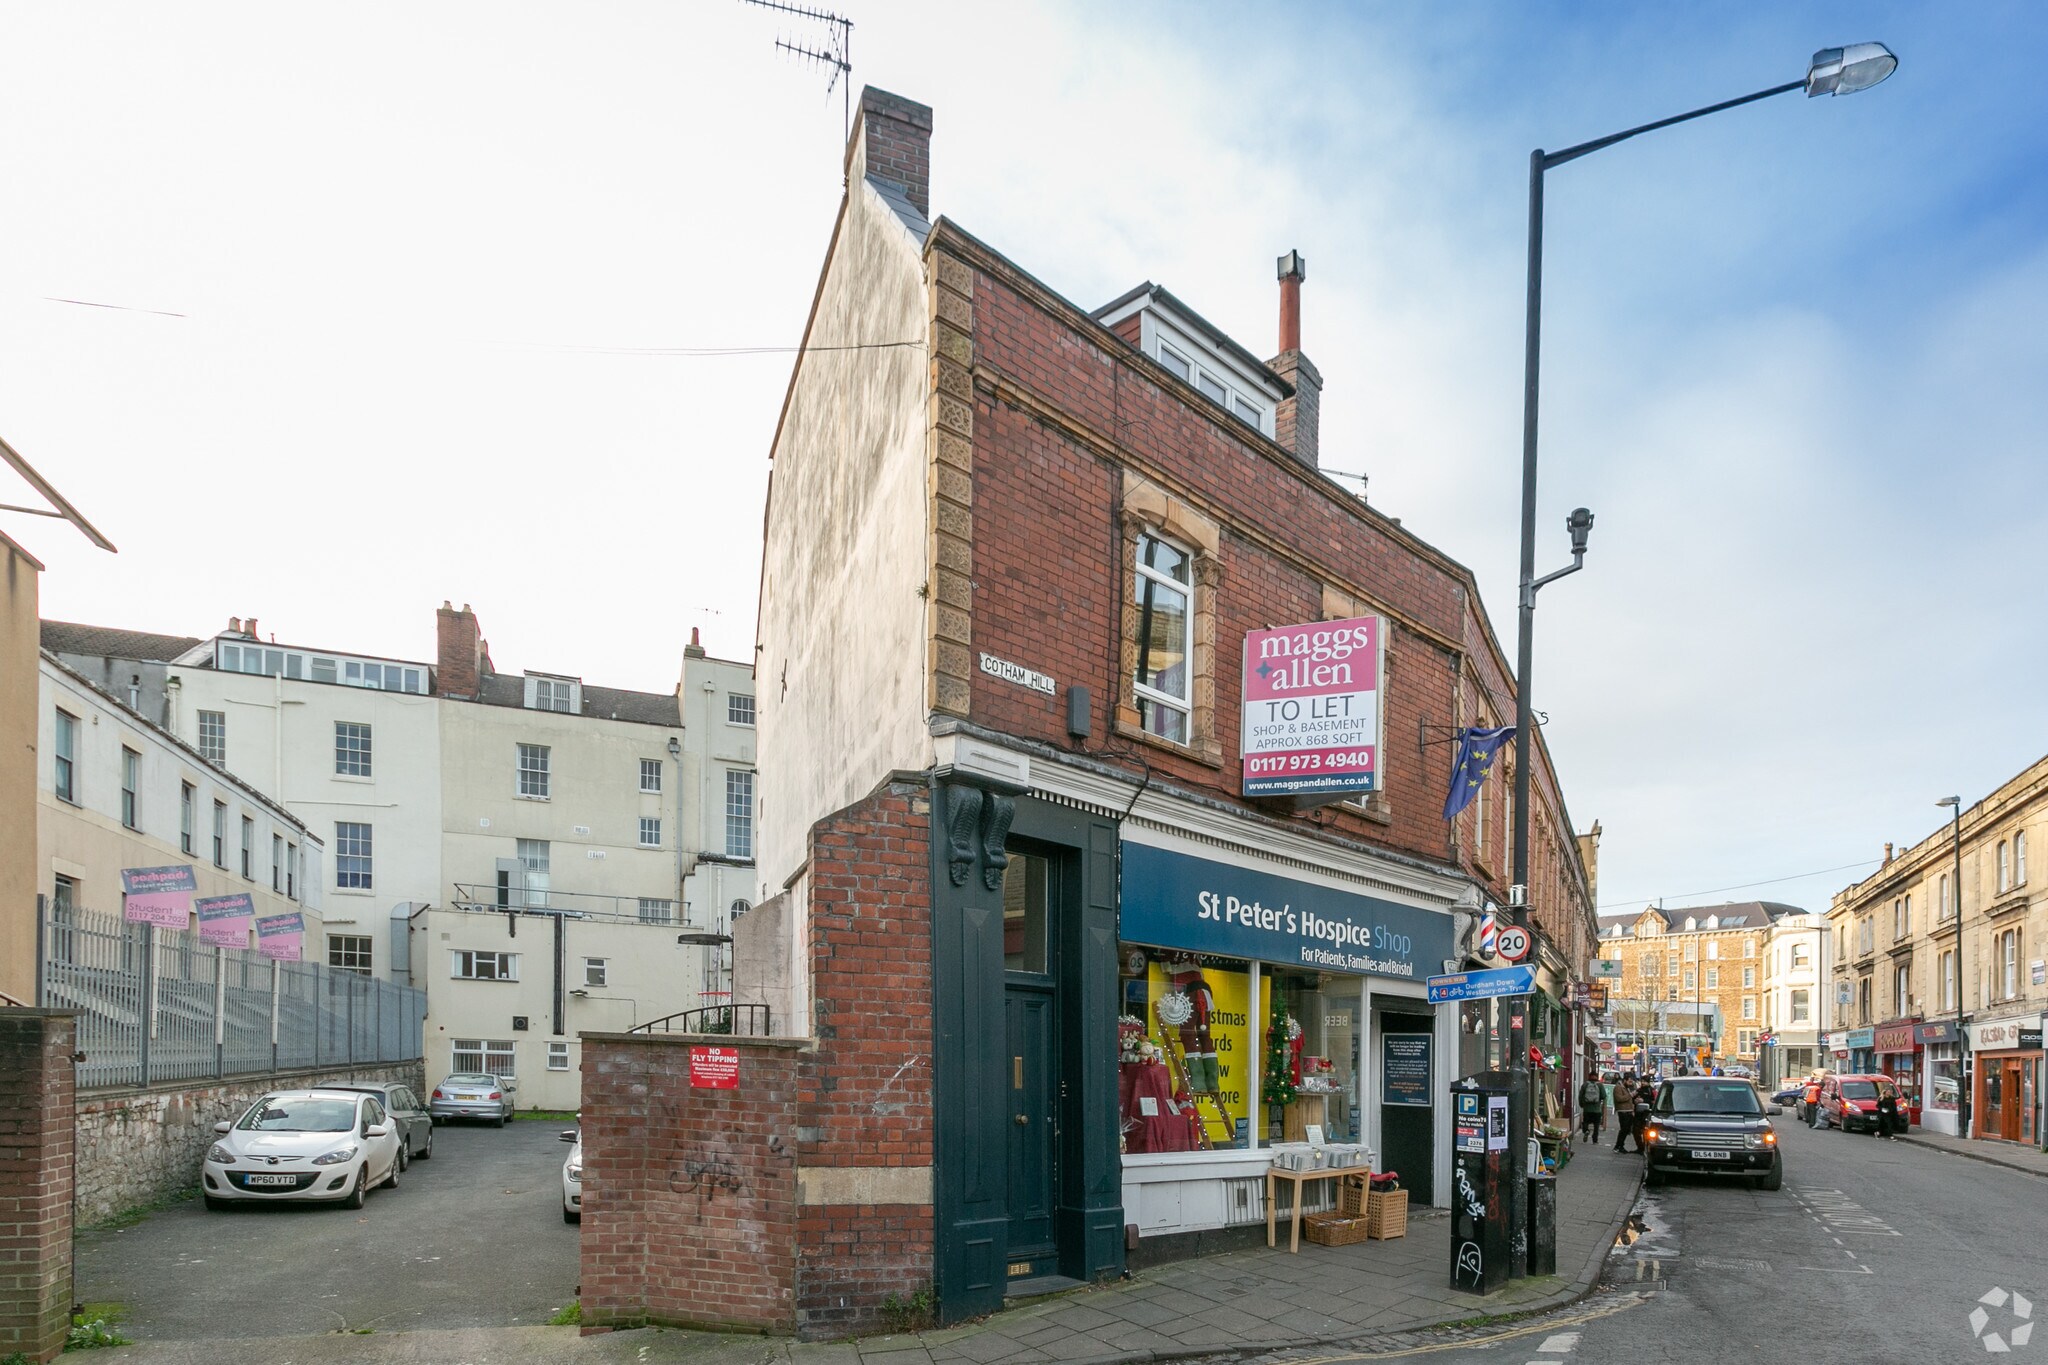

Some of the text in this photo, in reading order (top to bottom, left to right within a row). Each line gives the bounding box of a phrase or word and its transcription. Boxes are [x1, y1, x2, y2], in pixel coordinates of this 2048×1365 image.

[1260, 627, 1368, 661] maggs
[985, 657, 1052, 691] COTHAM HILL
[1272, 657, 1353, 690] allen
[1266, 695, 1354, 722] TO LET
[1253, 718, 1366, 736] SHOP & BASEMENT
[1256, 732, 1362, 749] APPROX 868 SQFT
[1250, 752, 1369, 772] 0117 973 4940
[1248, 776, 1369, 789] www.maggsandallen.co.uk
[131, 870, 188, 884] poshpads
[202, 897, 248, 911] poshpads
[168, 915, 187, 923] 7022
[1198, 890, 1411, 959] St Peter's Hospice Shop
[1501, 935, 1525, 951] 20
[1301, 946, 1413, 976] For Patients, Families and Bristol
[1465, 981, 1495, 990] Durdham
[1210, 1009, 1247, 1026] stmas
[707, 1055, 738, 1063] TIPPING
[1463, 1097, 1475, 1112] P
